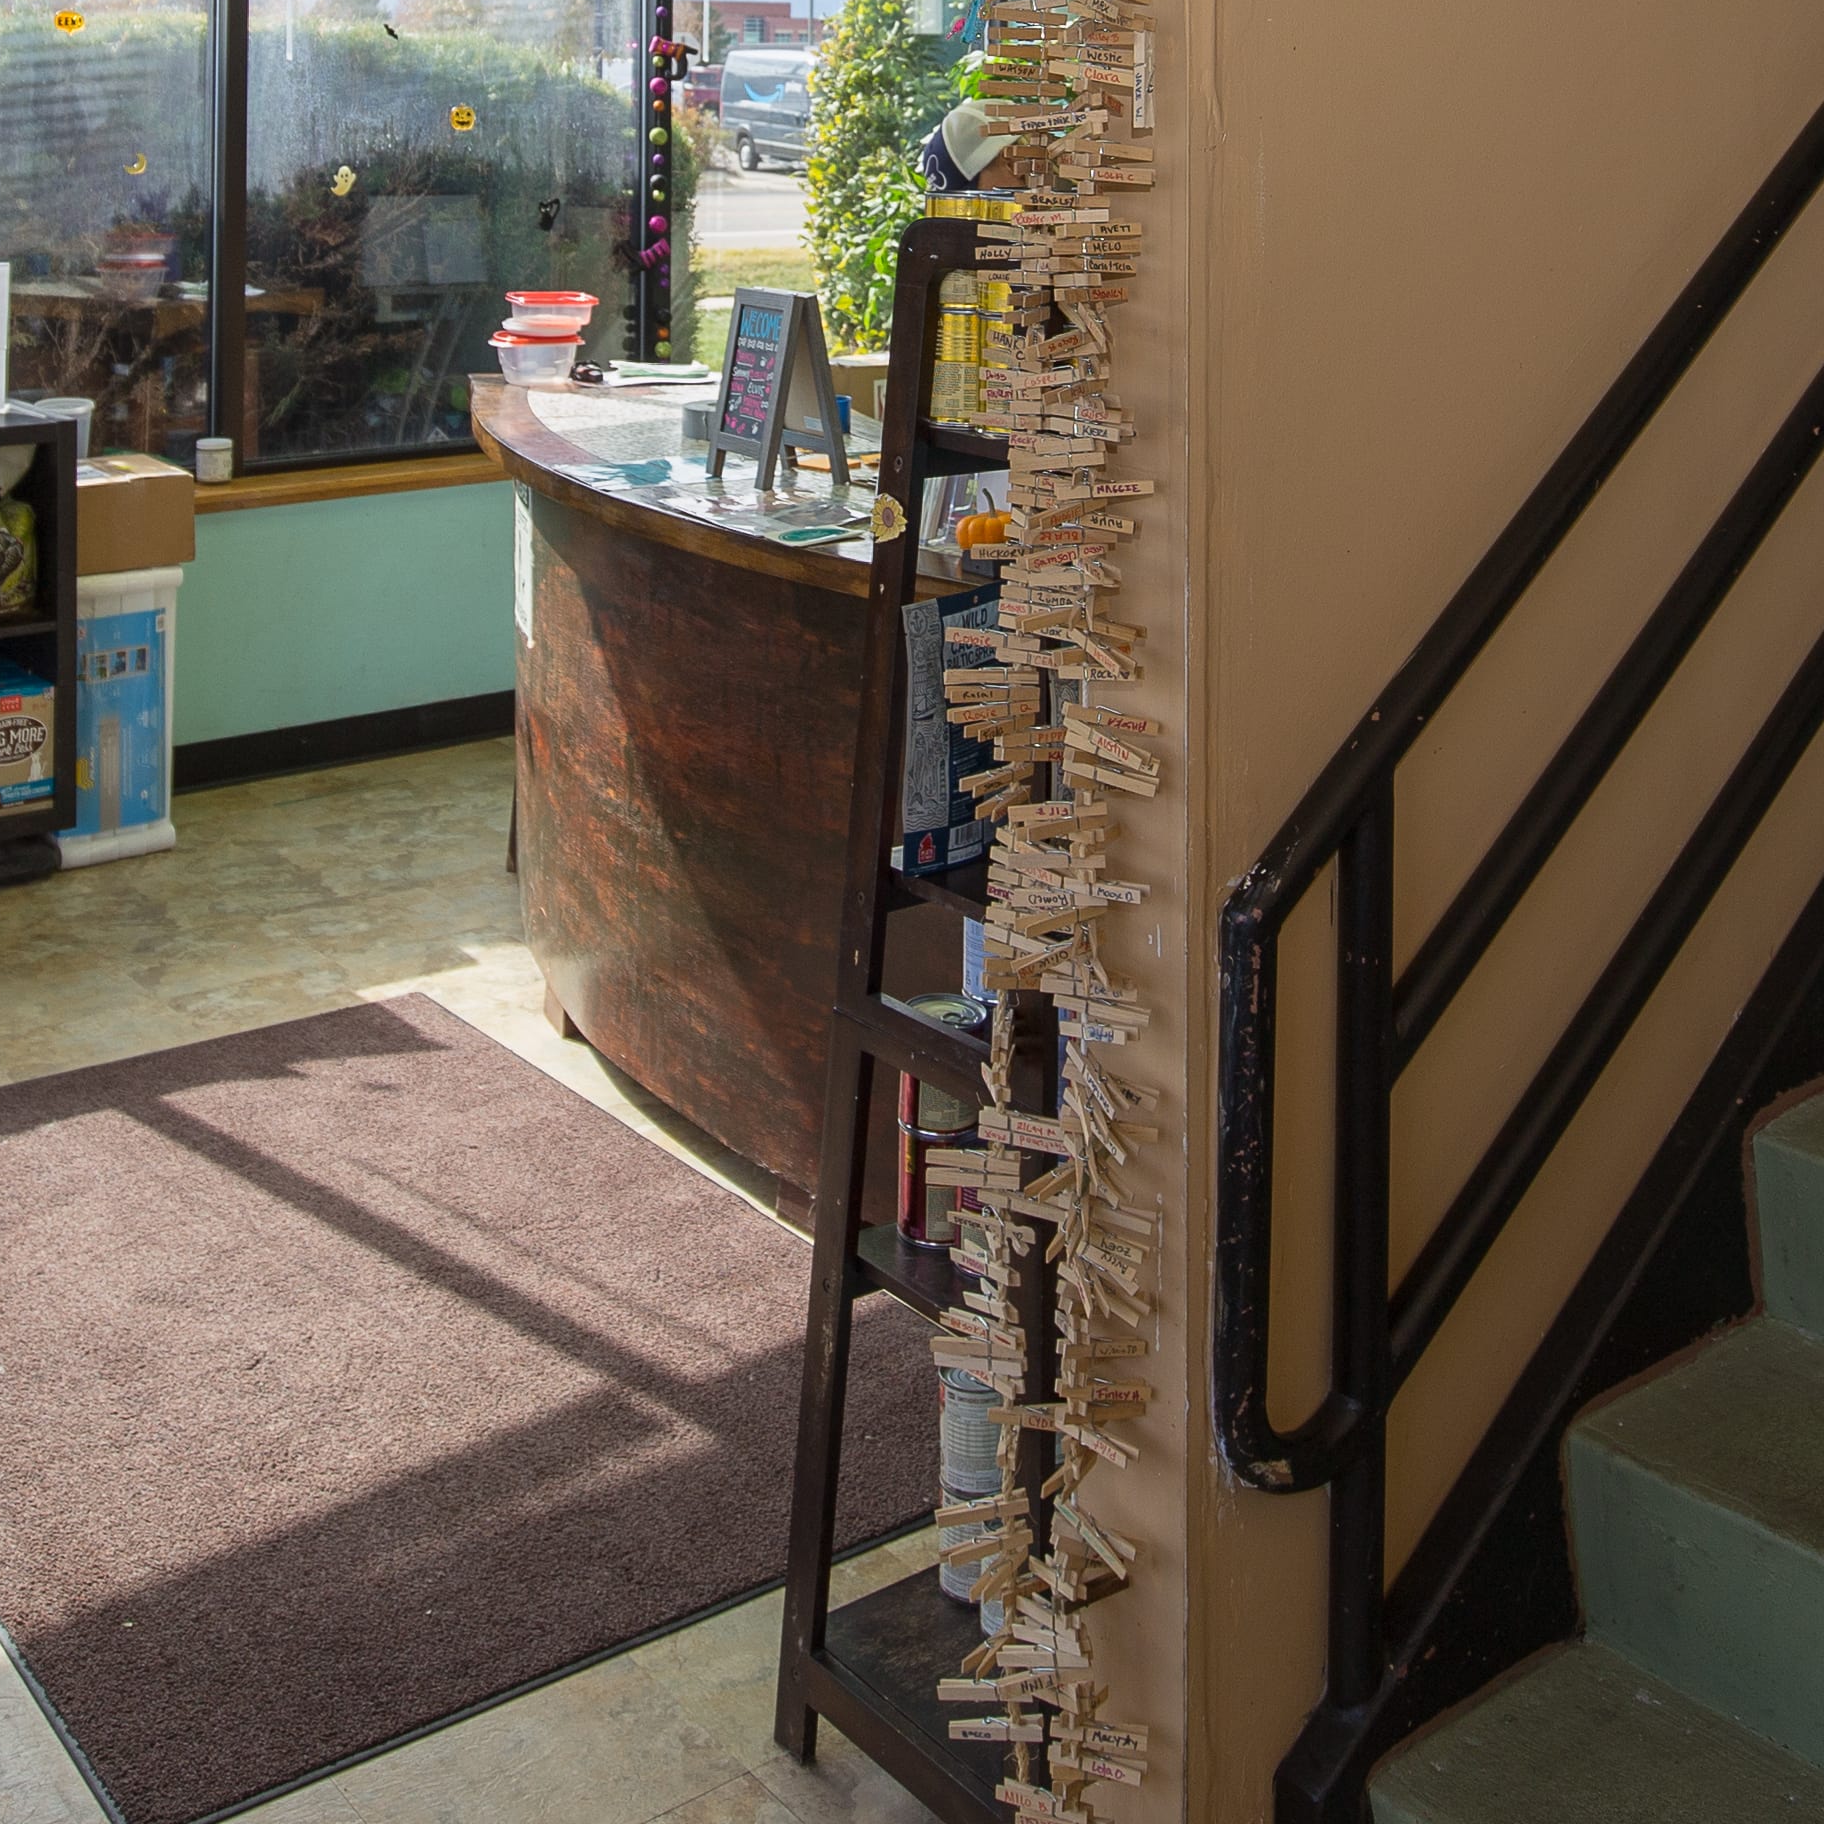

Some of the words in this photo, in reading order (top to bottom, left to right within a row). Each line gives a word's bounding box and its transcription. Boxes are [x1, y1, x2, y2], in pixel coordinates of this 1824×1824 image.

[1086, 49, 1124, 64] Westie
[1084, 67, 1121, 84] Clara
[979, 248, 1012, 259] HOLLY
[1096, 483, 1142, 495] MAGGIE
[978, 547, 1026, 559] HICKORY
[1033, 550, 1078, 569] Samson
[961, 607, 988, 629] WILD
[9, 727, 44, 745] MORE
[1097, 737, 1130, 761] AUSTIN
[1095, 1389, 1131, 1401] Finley
[1004, 1790, 1033, 1807] Milo
